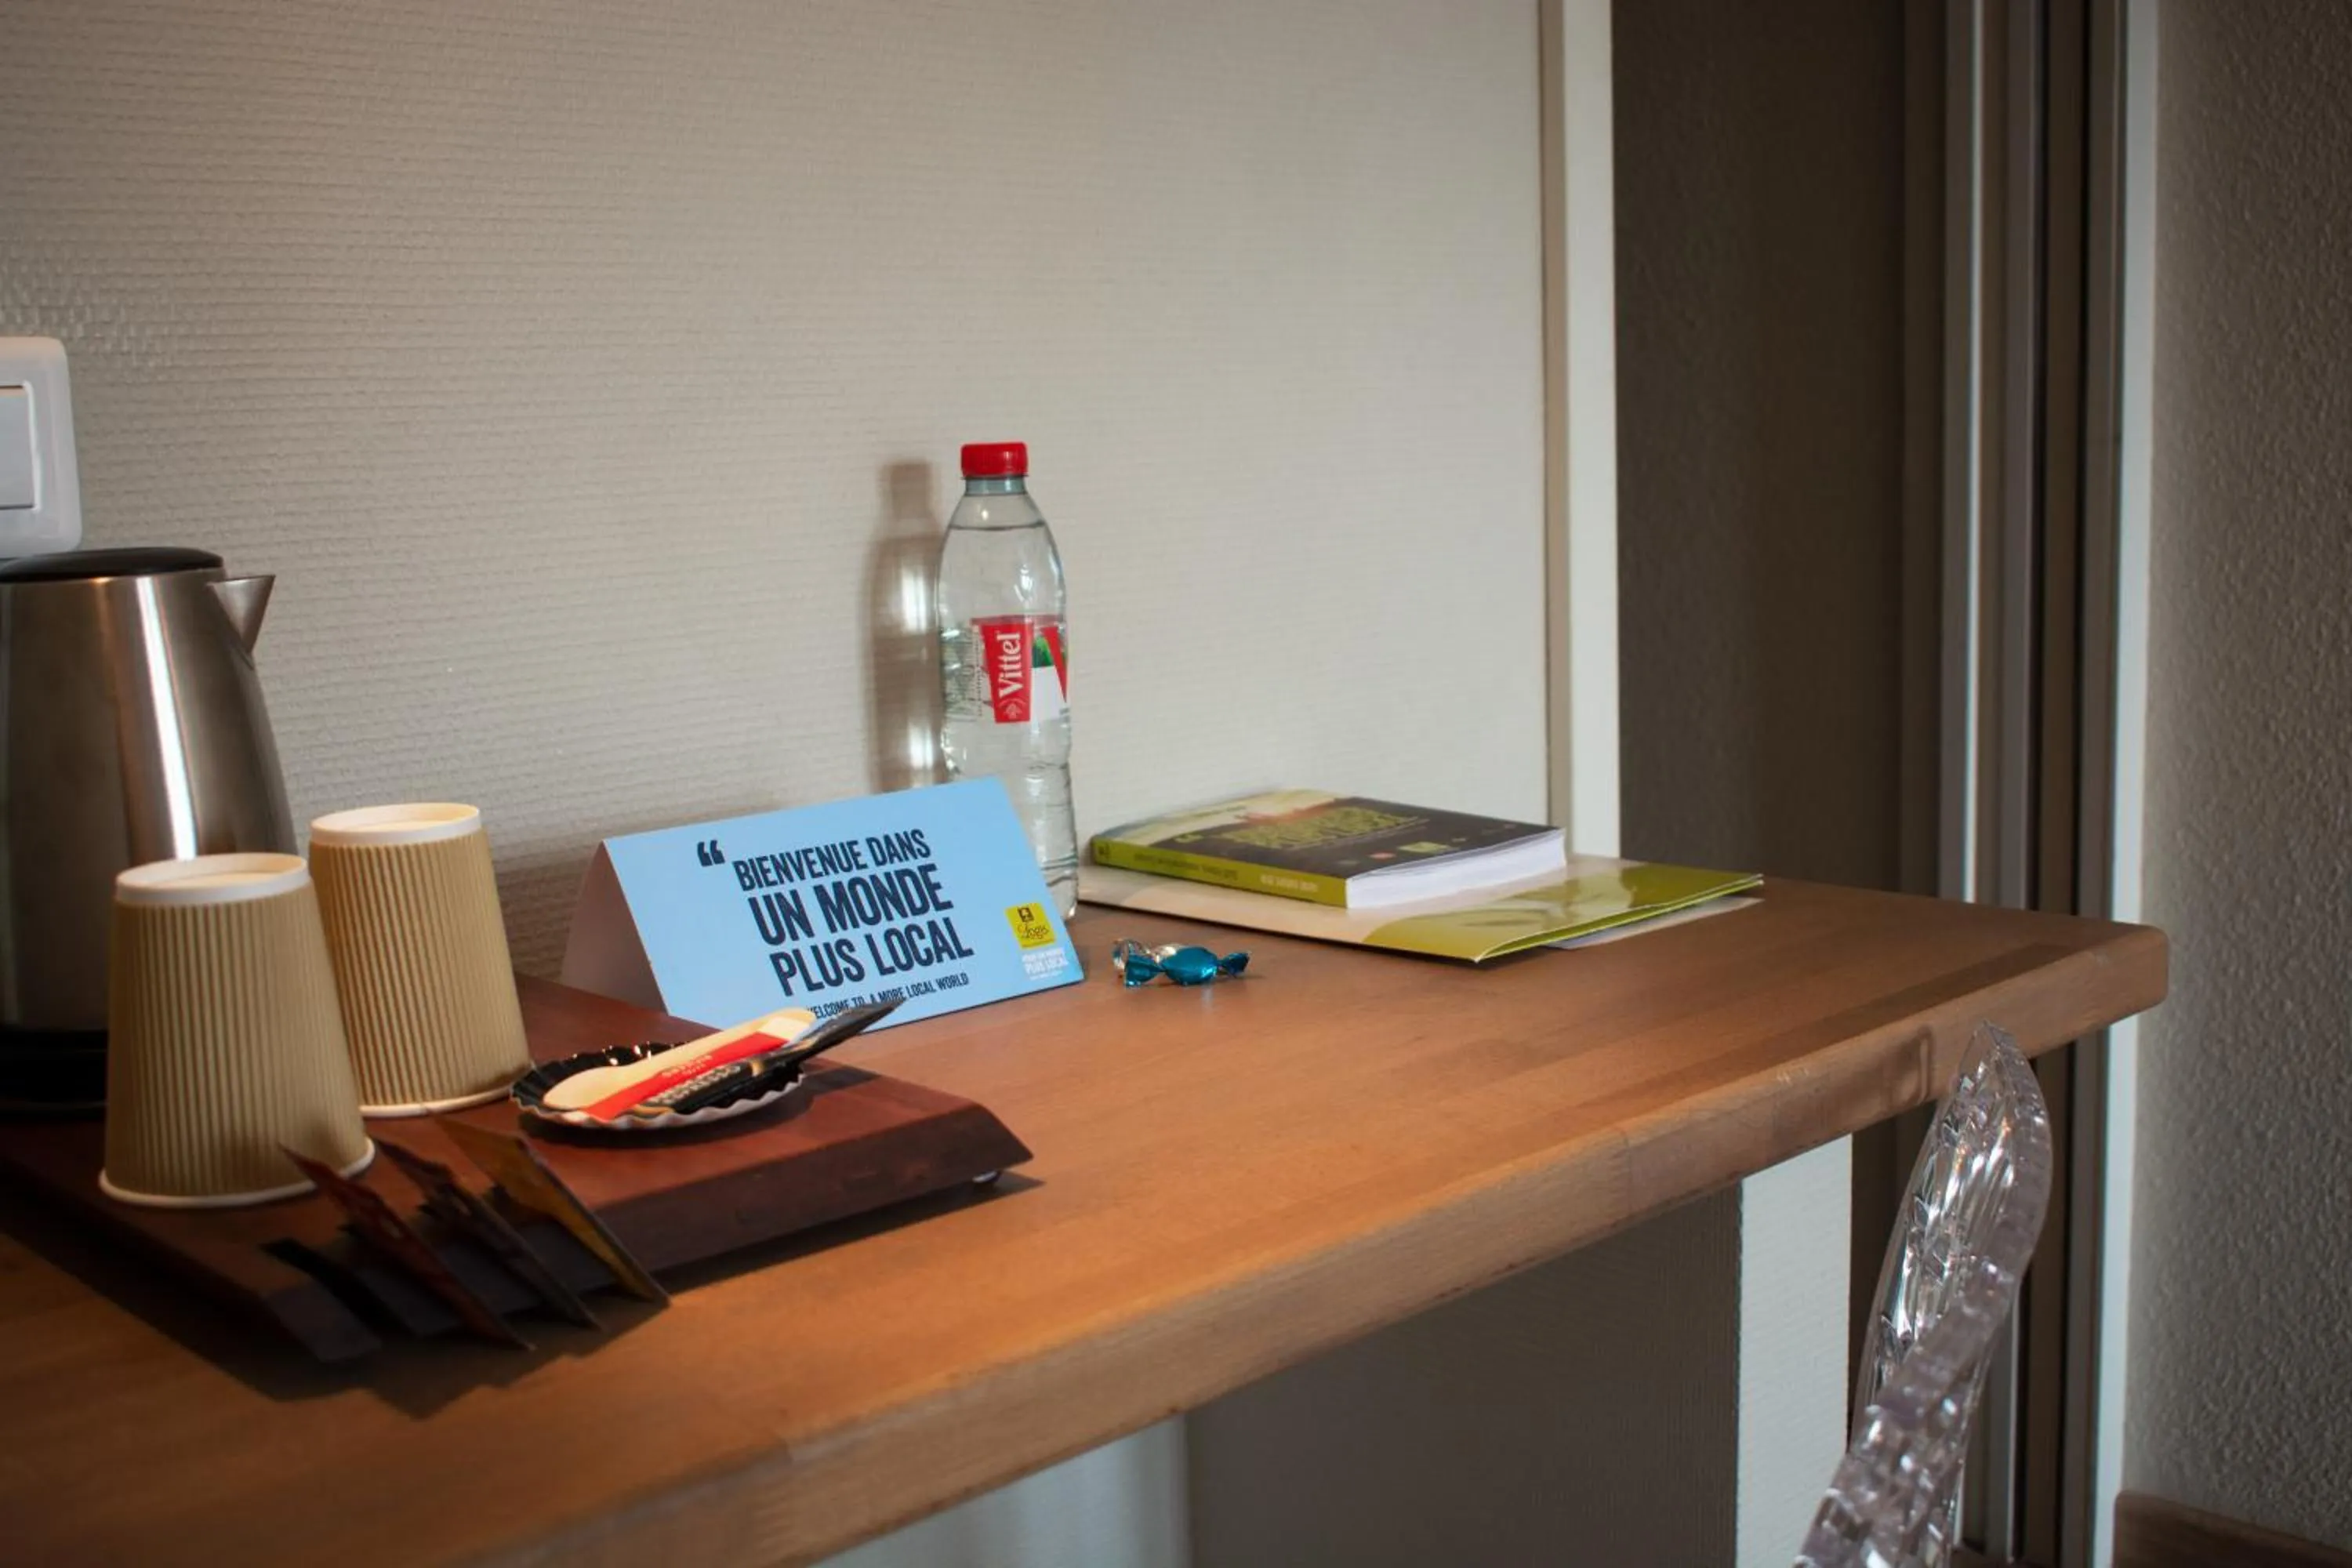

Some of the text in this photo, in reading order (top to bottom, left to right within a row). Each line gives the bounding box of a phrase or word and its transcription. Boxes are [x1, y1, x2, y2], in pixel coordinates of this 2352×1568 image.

[996, 633, 1023, 698] Vittel
[732, 840, 868, 891] BIENVENUE
[865, 829, 931, 868] DANS
[747, 863, 954, 946] UN MONDE
[769, 916, 975, 996] PLUS LOCAL
[807, 999, 849, 1018] ELCOME
[905, 982, 936, 997] LOCAL
[935, 972, 970, 992] WORLD
